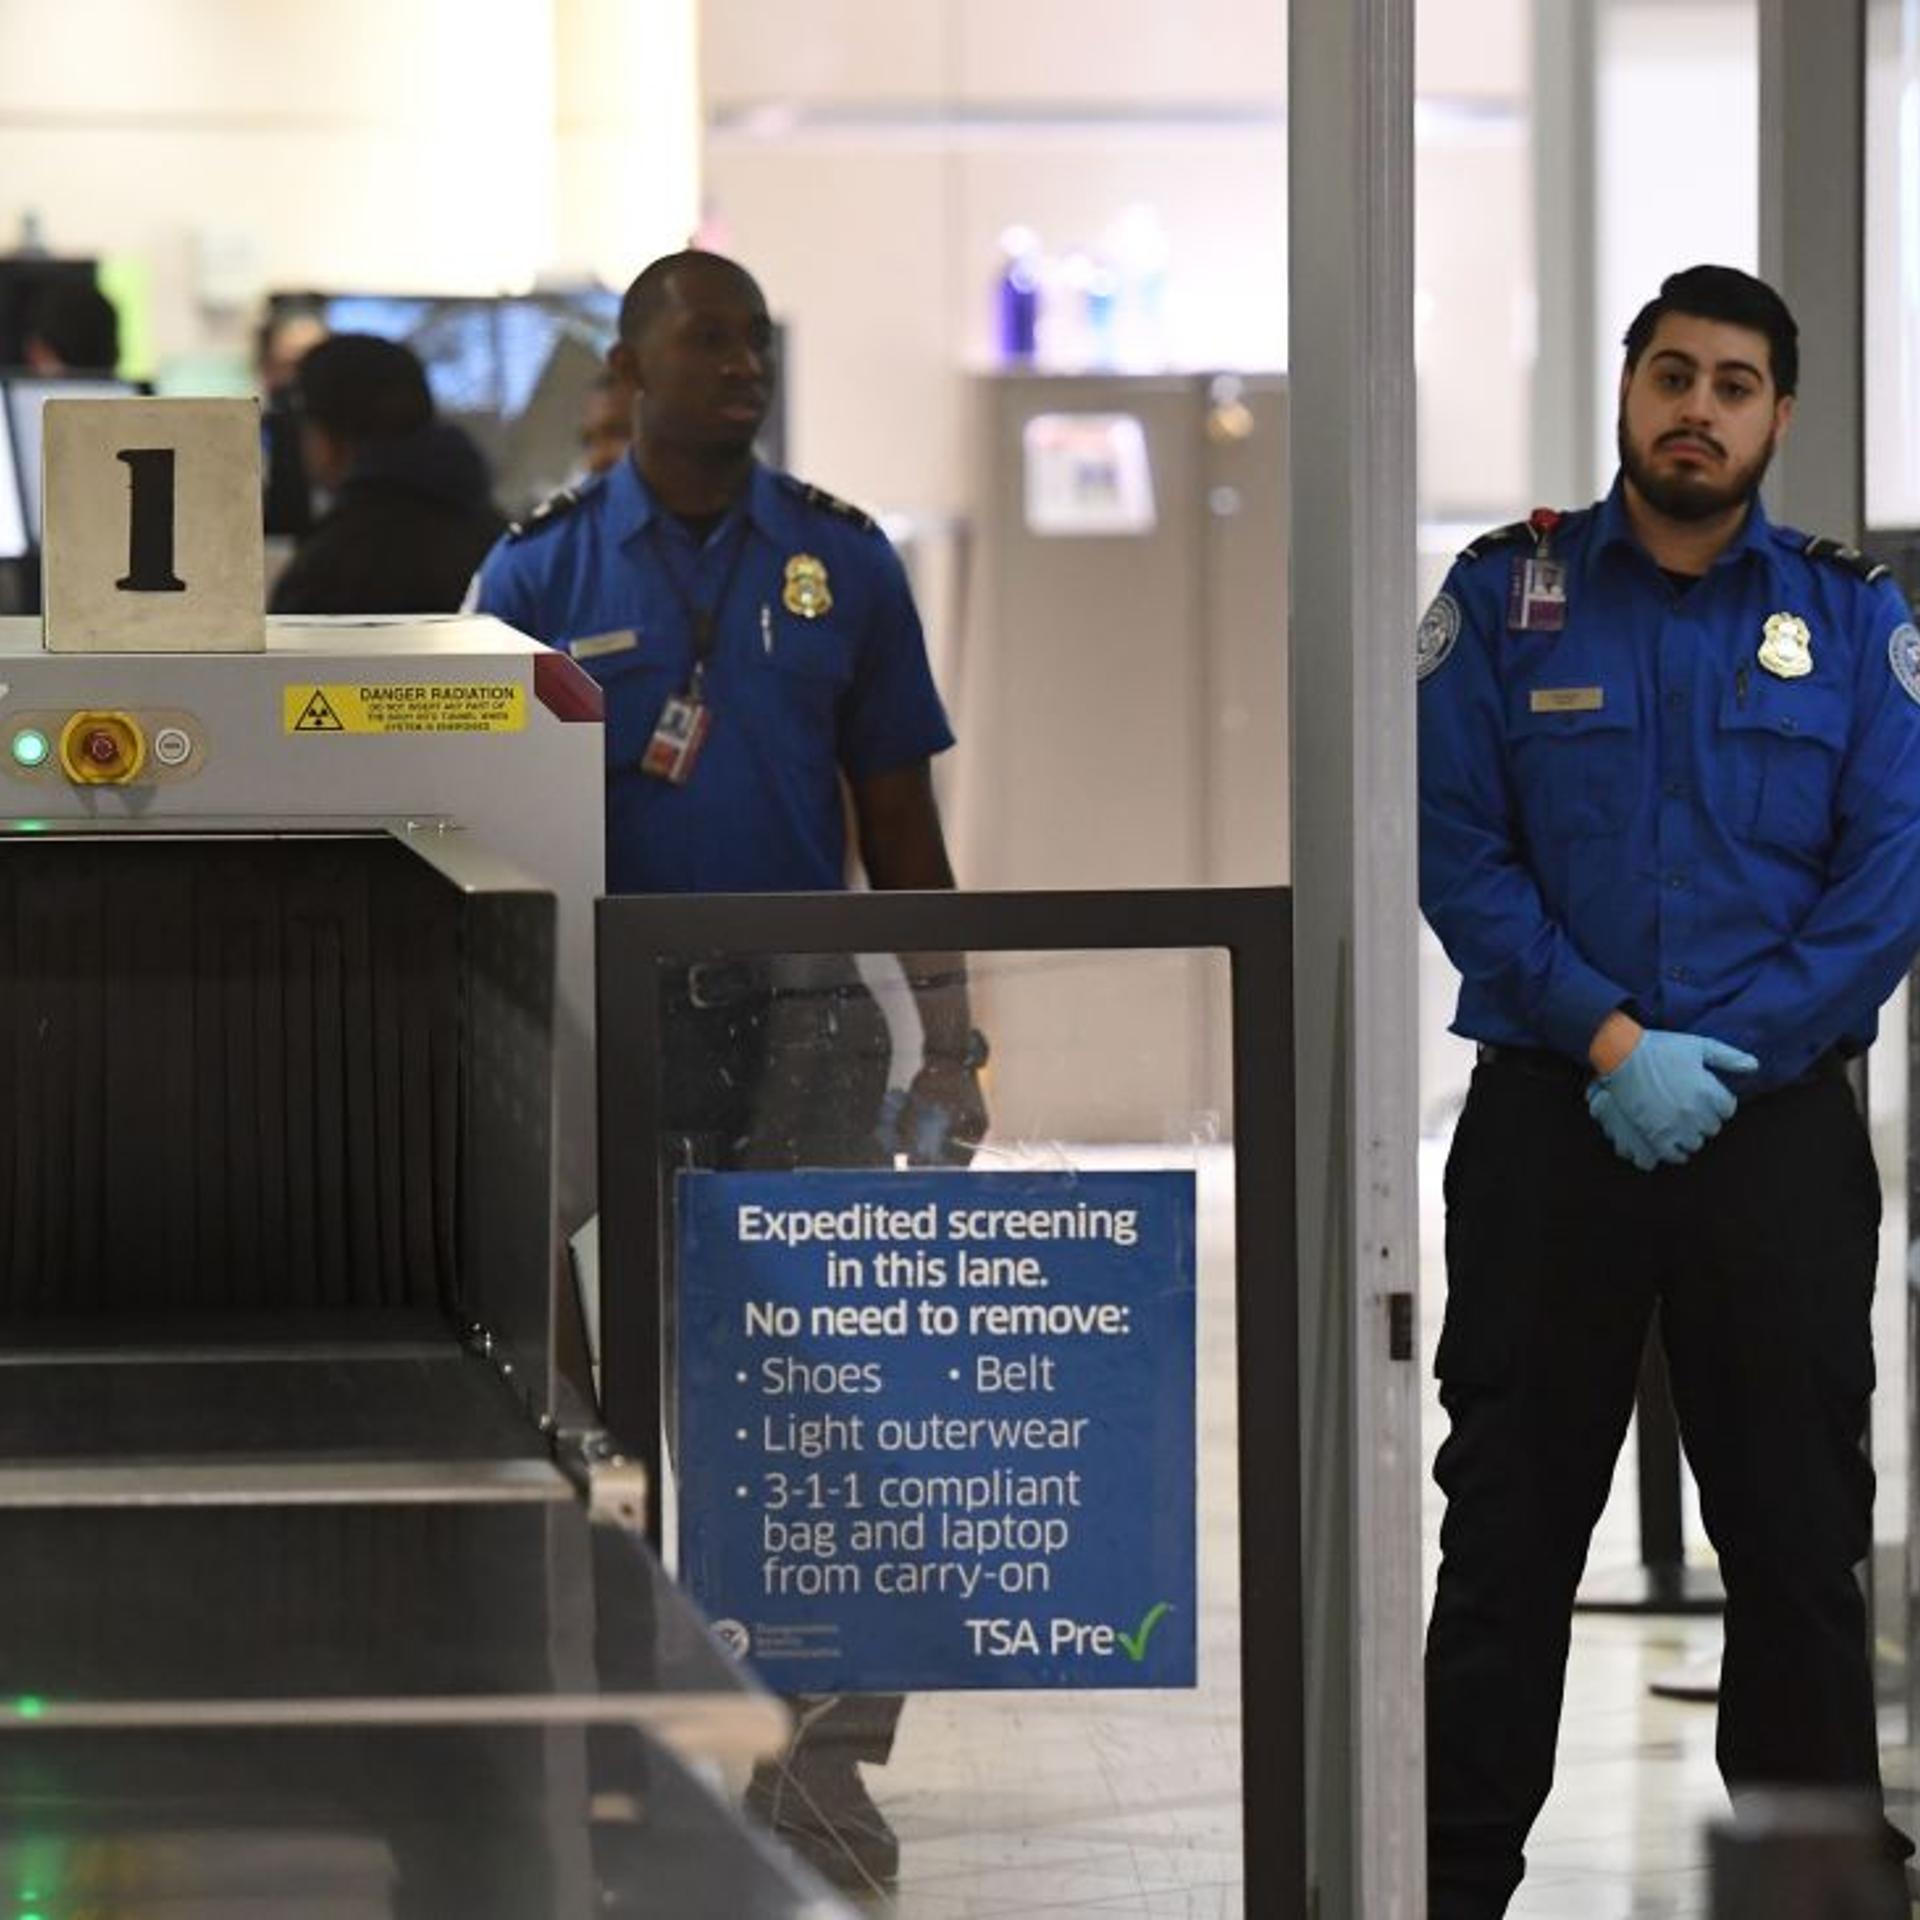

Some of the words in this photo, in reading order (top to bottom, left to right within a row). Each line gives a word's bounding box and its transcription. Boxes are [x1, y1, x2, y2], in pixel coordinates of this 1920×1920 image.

[115, 449, 187, 592] 1
[360, 687, 426, 701] DANGER
[431, 686, 515, 700] RADIATION
[739, 1203, 937, 1247] Expedited
[948, 1202, 1138, 1245] screening
[828, 1251, 863, 1288] in
[873, 1250, 947, 1288] this
[959, 1250, 1048, 1288] lane.
[746, 1302, 800, 1336] No
[812, 1299, 908, 1336] need
[918, 1300, 959, 1335] to
[970, 1302, 1130, 1336] remove:
[763, 1355, 882, 1394] Shoes
[977, 1354, 1054, 1392] Belt
[765, 1414, 863, 1458] Light
[878, 1414, 1088, 1451] outerwear
[765, 1473, 861, 1509] 3-1-1
[880, 1469, 1080, 1513] compliant
[765, 1514, 836, 1557] bag
[851, 1512, 924, 1550] and
[942, 1513, 1068, 1556] laptop
[764, 1556, 860, 1595] from
[876, 1562, 1050, 1599] carry-on
[965, 1618, 1040, 1656] TSA
[1051, 1618, 1114, 1656] Pre
